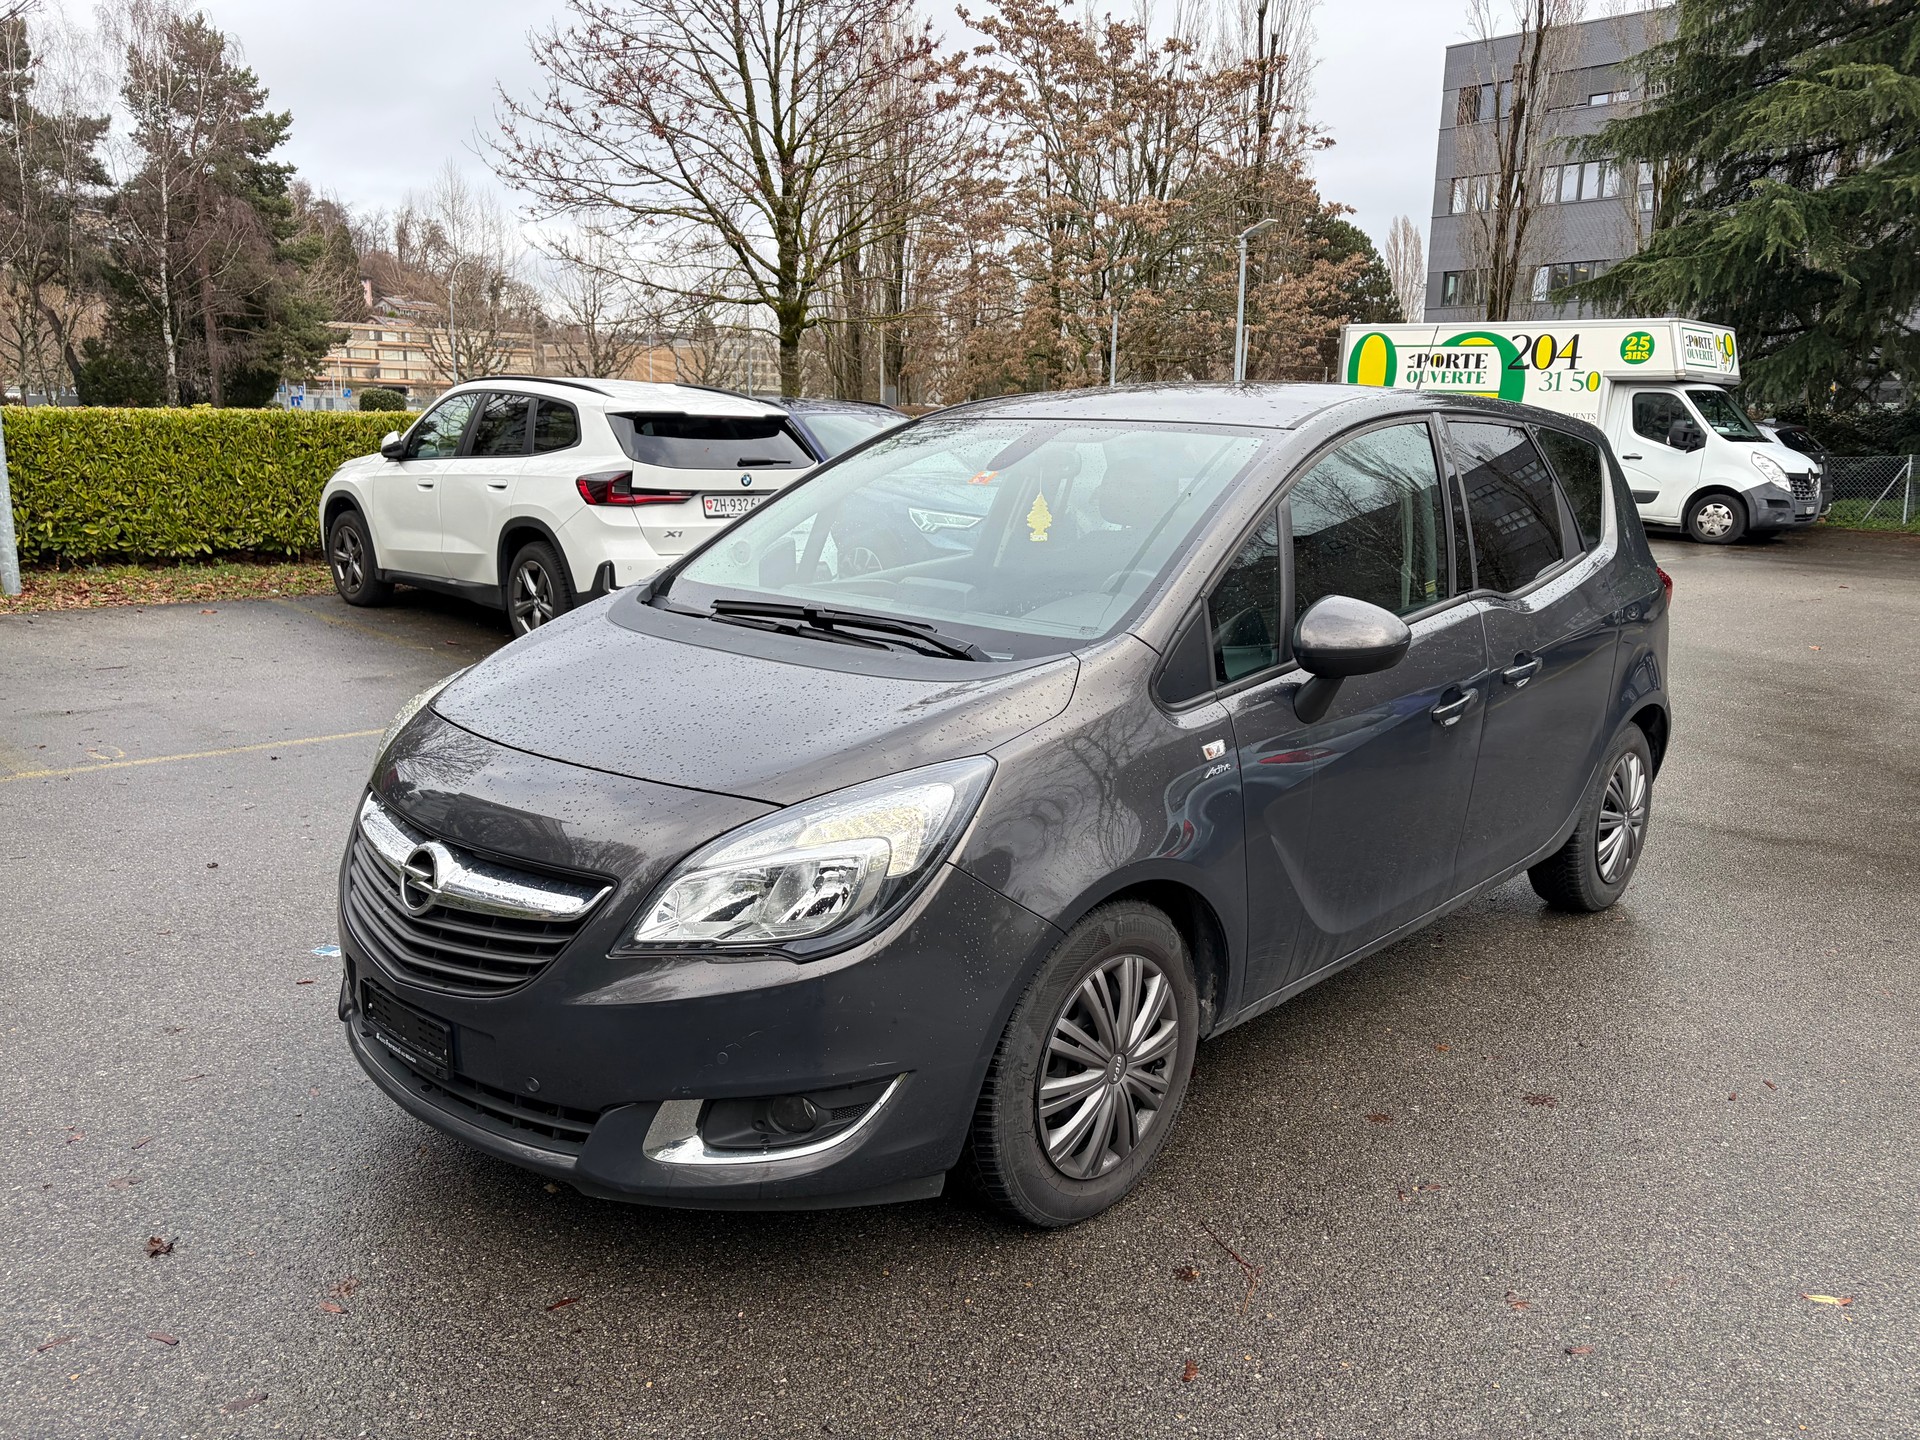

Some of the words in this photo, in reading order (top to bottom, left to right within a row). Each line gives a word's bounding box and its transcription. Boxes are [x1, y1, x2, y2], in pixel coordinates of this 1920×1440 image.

[1625, 335, 1651, 351] 25
[1687, 335, 1713, 350] PORTE
[1508, 333, 1583, 371] 204
[1623, 350, 1650, 361] ans
[1687, 348, 1714, 361] OUVERTE
[1416, 353, 1489, 369] PORTE
[1406, 370, 1487, 385] OUVERTE
[1538, 371, 1563, 392] 31
[1570, 371, 1602, 393] 50
[664, 530, 684, 538] X1
